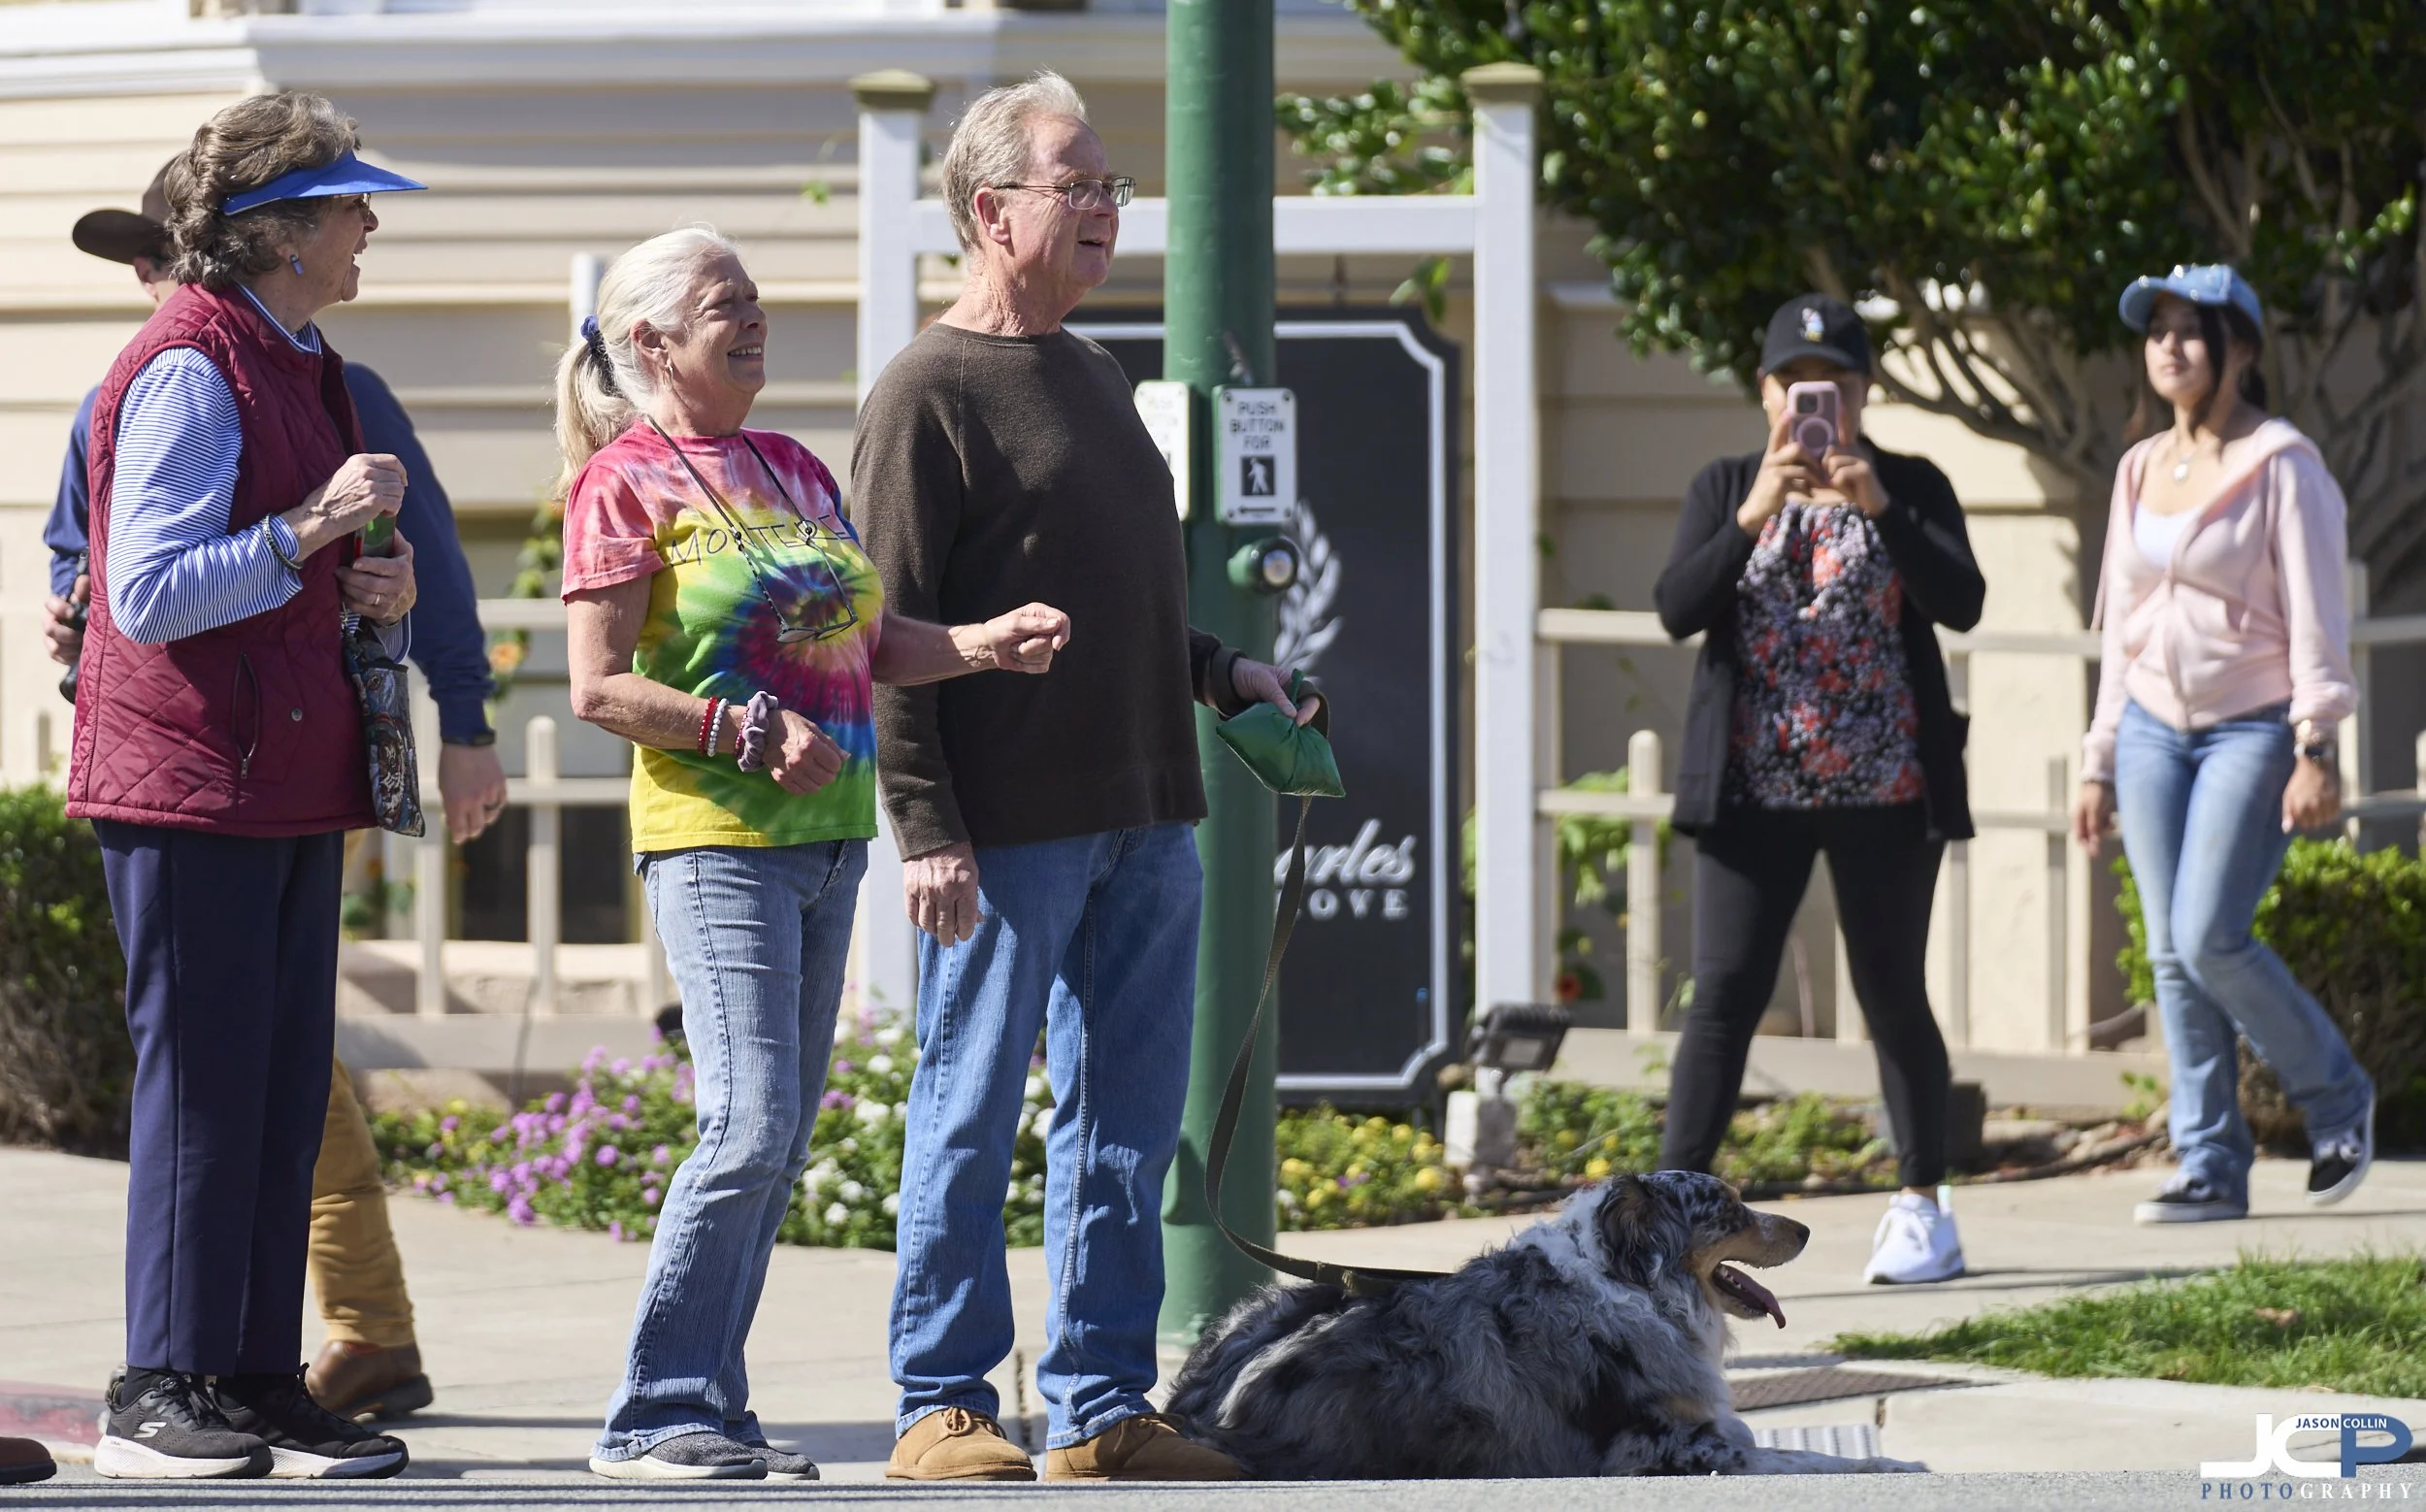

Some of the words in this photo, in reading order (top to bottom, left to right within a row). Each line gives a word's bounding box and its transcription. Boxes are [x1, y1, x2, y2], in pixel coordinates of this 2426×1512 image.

[1237, 401, 1277, 415] PUSH
[1229, 418, 1285, 435] BUTTON
[1243, 436, 1272, 450] FOR
[1274, 888, 1410, 921] OVE
